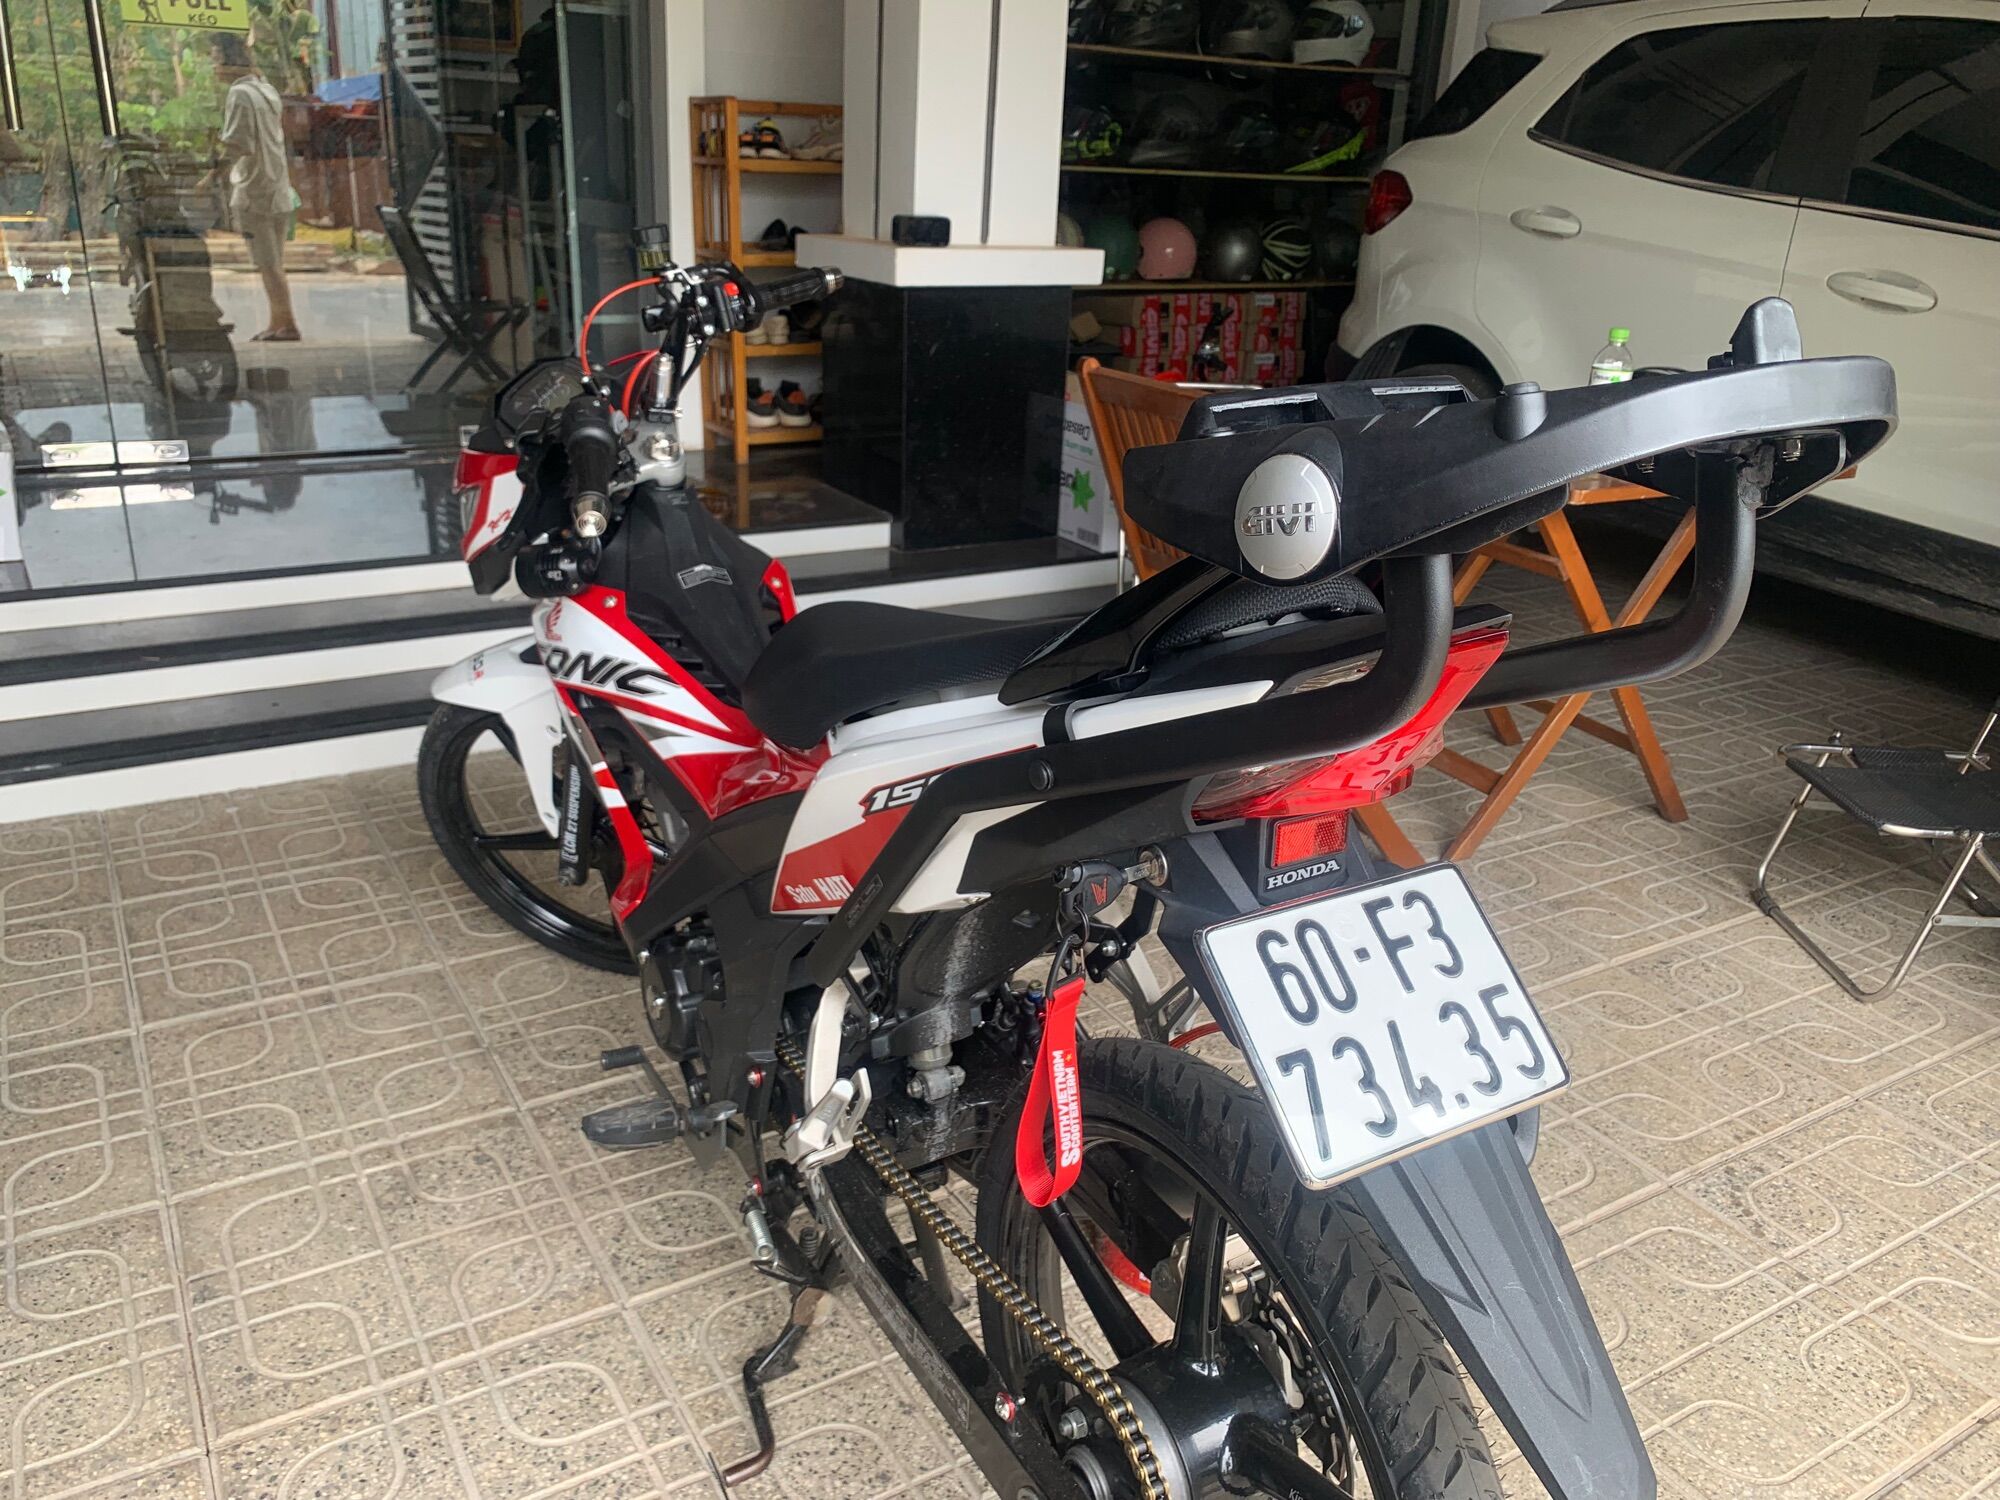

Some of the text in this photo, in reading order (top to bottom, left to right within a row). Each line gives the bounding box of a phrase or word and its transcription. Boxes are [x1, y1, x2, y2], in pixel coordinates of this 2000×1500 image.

[1241, 502, 1316, 536] GIVI
[540, 645, 682, 697] ONIC
[870, 774, 942, 812] 15
[1267, 860, 1340, 889] HONDA
[784, 884, 822, 904] Satu
[1275, 983, 1546, 1161] 734.35
